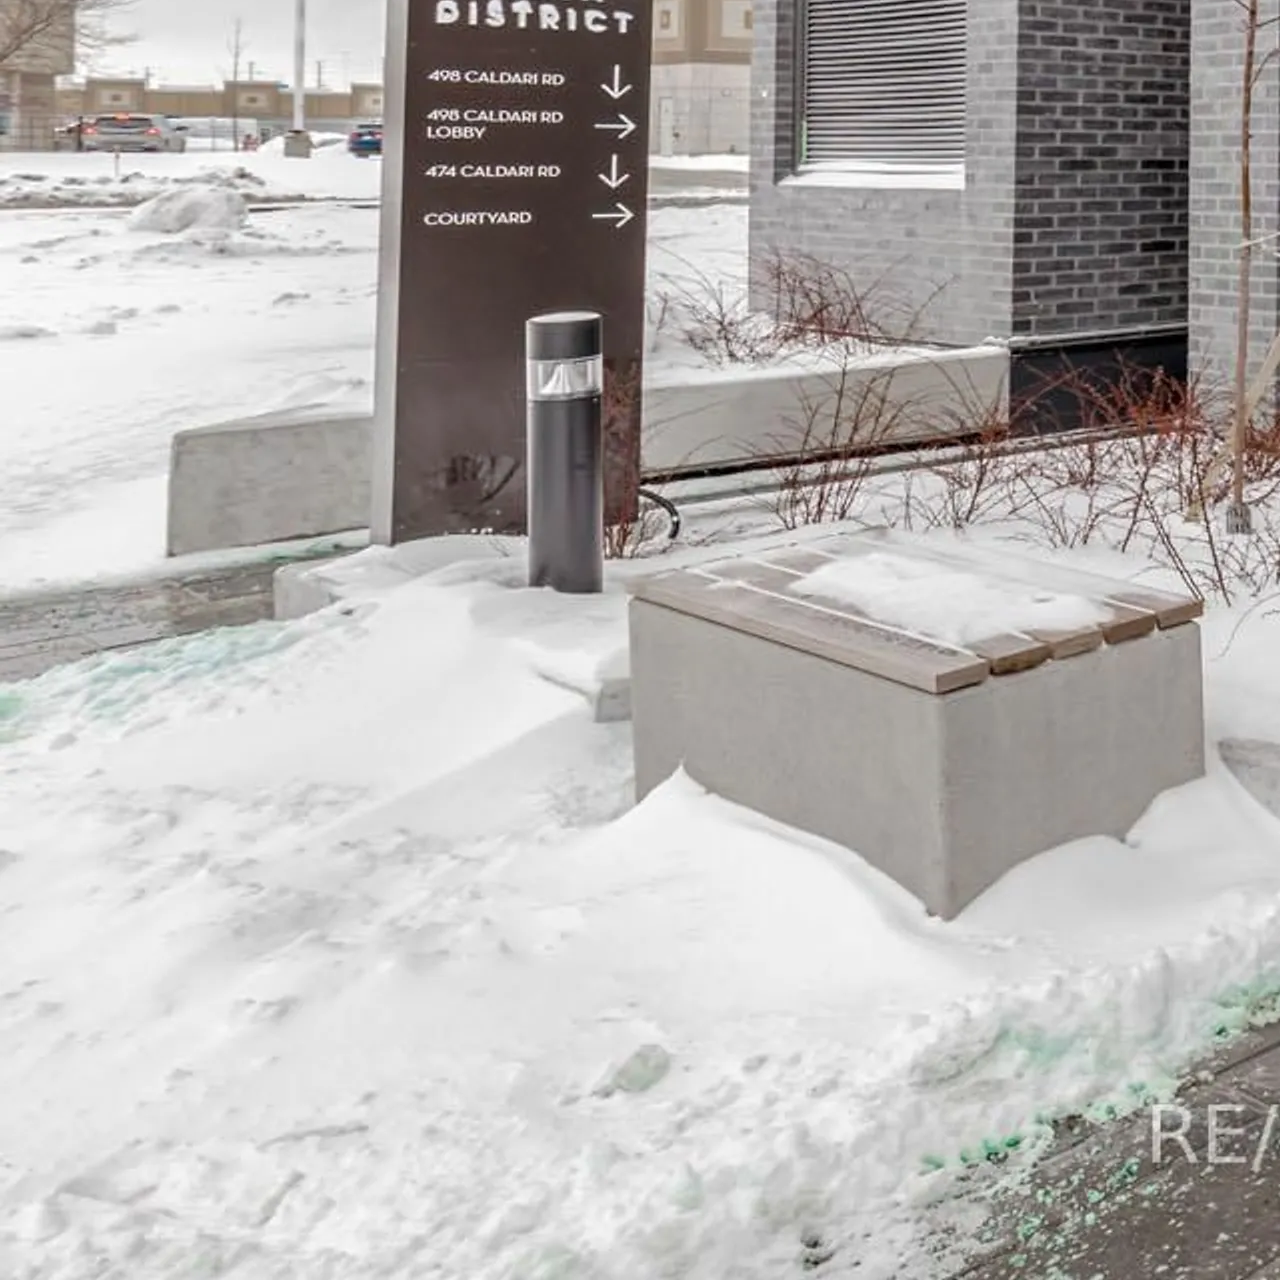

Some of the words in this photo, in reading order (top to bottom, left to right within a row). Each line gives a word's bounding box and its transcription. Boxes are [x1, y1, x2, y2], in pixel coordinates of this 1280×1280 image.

[427, 69, 461, 82] 498
[464, 70, 538, 85] CALDARI
[541, 73, 566, 86] RD
[427, 108, 460, 122] 498
[463, 109, 537, 123] CALDARI
[540, 111, 564, 124] RD
[427, 125, 487, 139] LOBBY
[425, 165, 457, 177] 474
[460, 165, 534, 177] CALDARI
[537, 166, 561, 177] RD
[423, 211, 532, 226] COURTYARD
